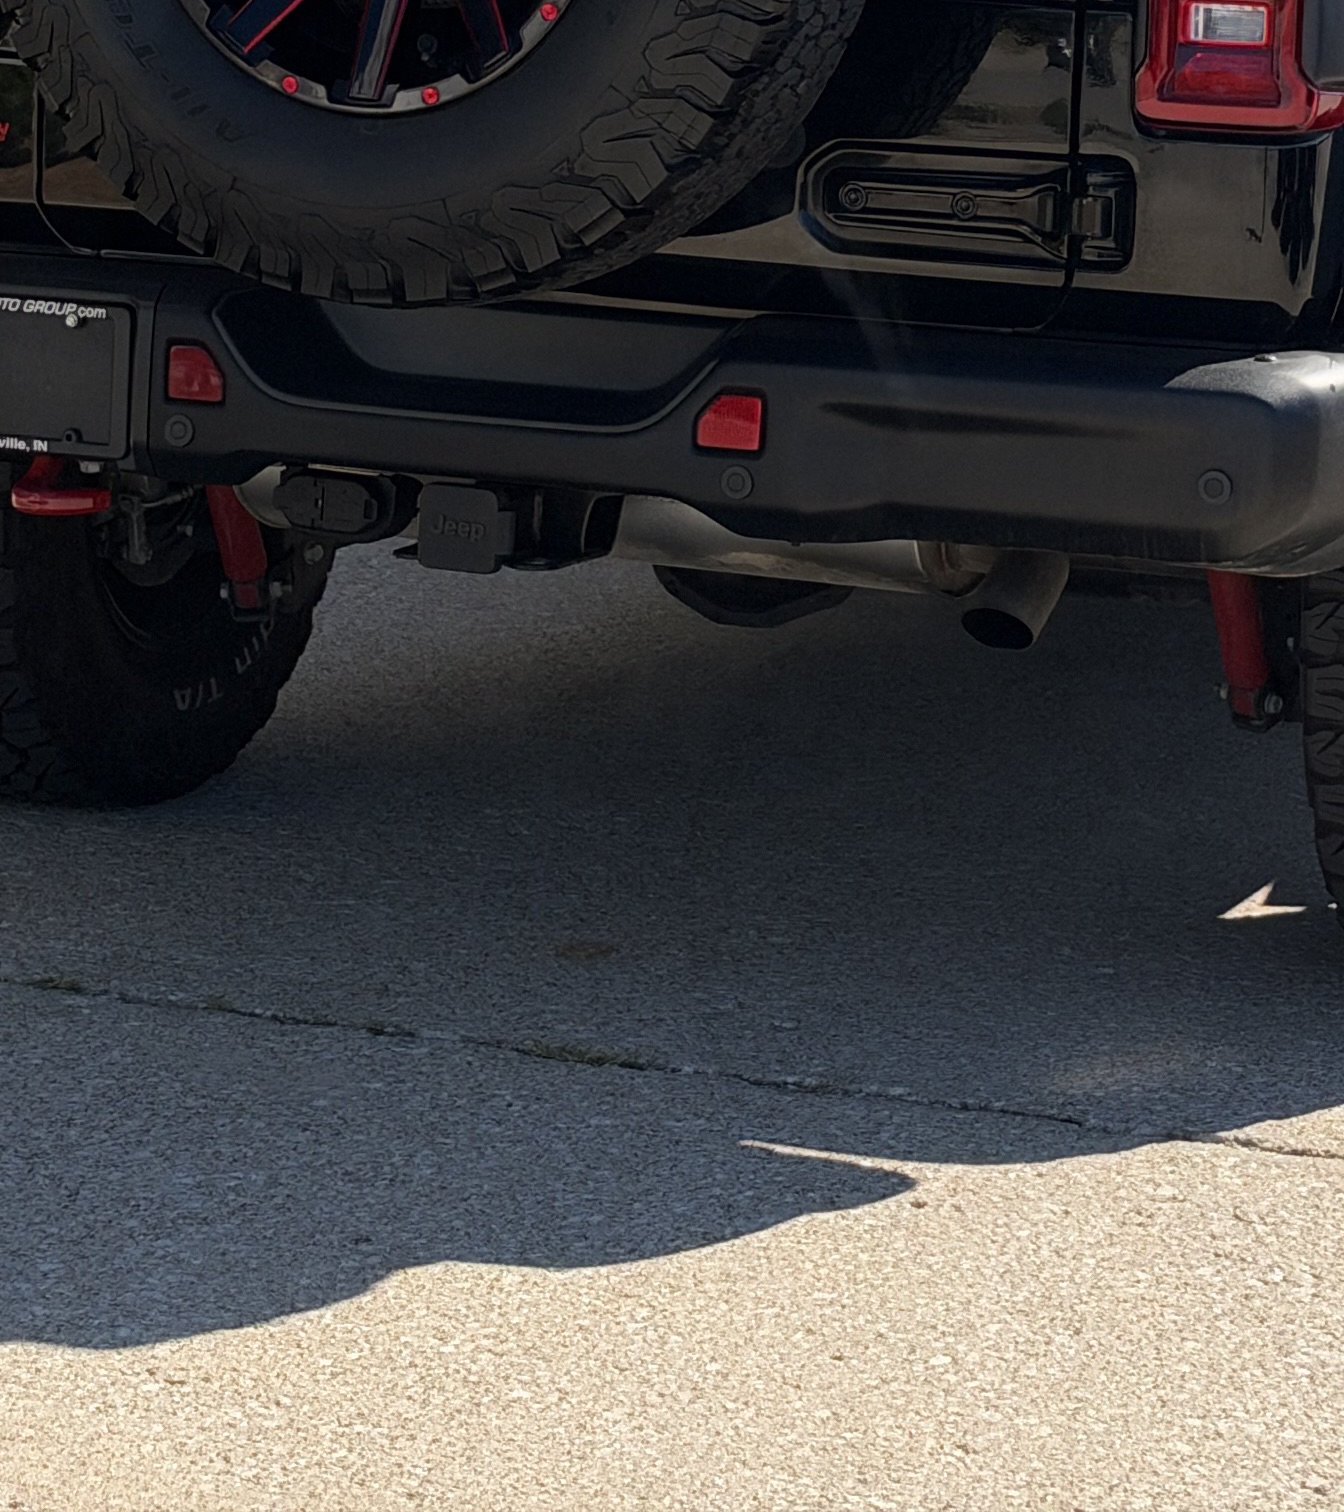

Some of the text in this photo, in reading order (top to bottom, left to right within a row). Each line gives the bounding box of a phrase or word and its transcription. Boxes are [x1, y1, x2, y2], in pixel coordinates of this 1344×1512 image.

[22, 299, 107, 318] GROUPcom
[32, 439, 49, 453] IN
[429, 511, 486, 543] Jeep
